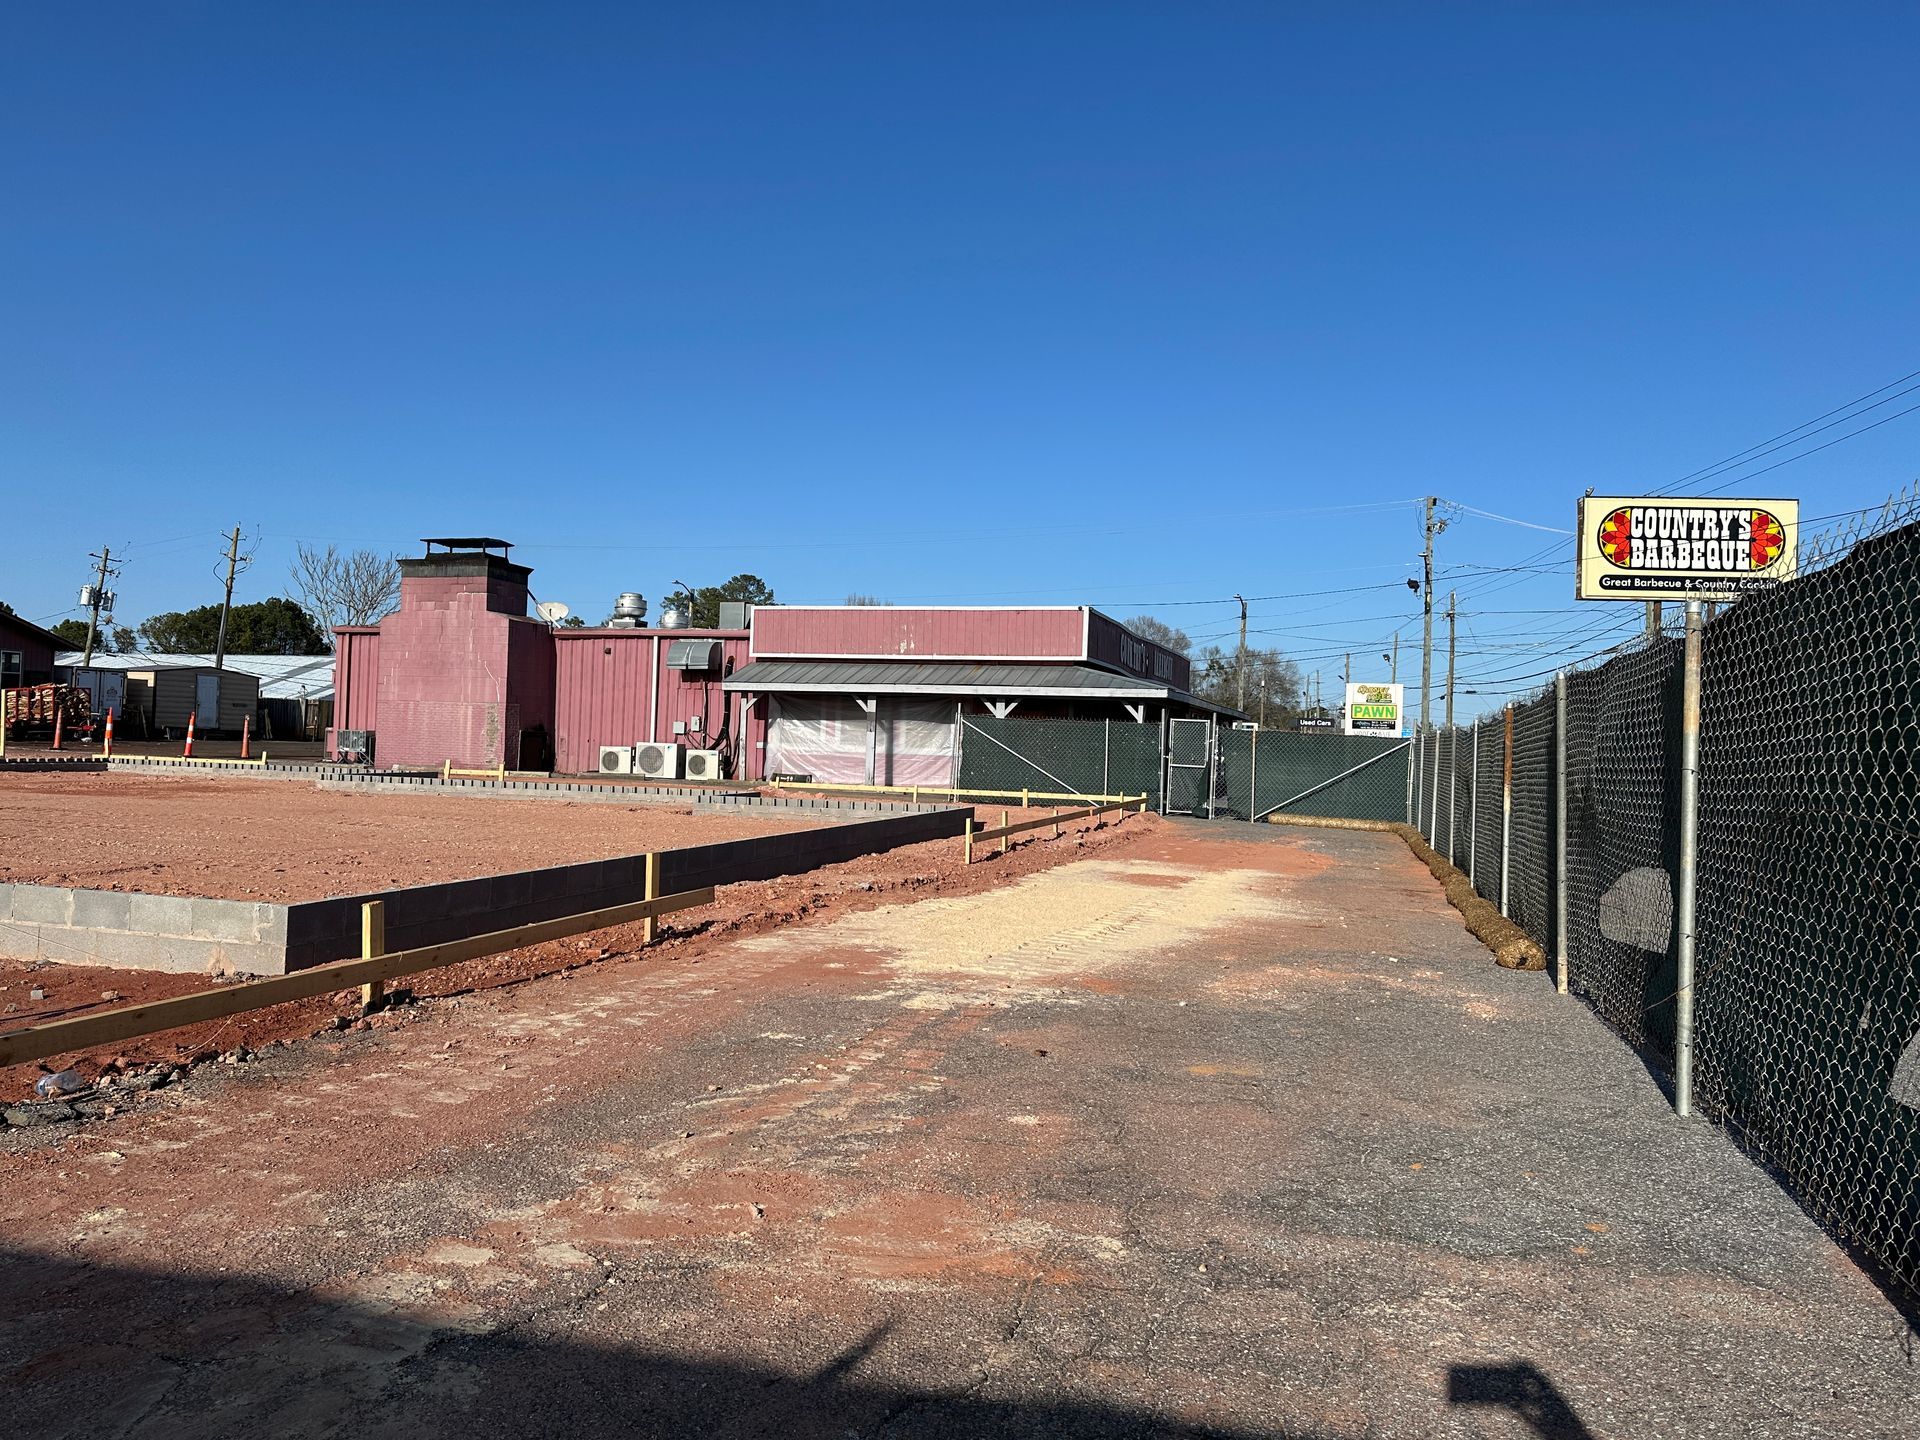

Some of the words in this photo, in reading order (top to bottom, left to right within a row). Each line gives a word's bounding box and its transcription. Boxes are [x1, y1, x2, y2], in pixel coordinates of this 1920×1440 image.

[1631, 508, 1751, 541] COUNTRY'S
[1630, 539, 1750, 571] BARBEQUE
[1602, 577, 1632, 588] Great
[1634, 577, 1681, 588] Barbecue
[1684, 579, 1692, 588] &
[1695, 578, 1737, 591] Country
[1354, 706, 1394, 717] PAWN
